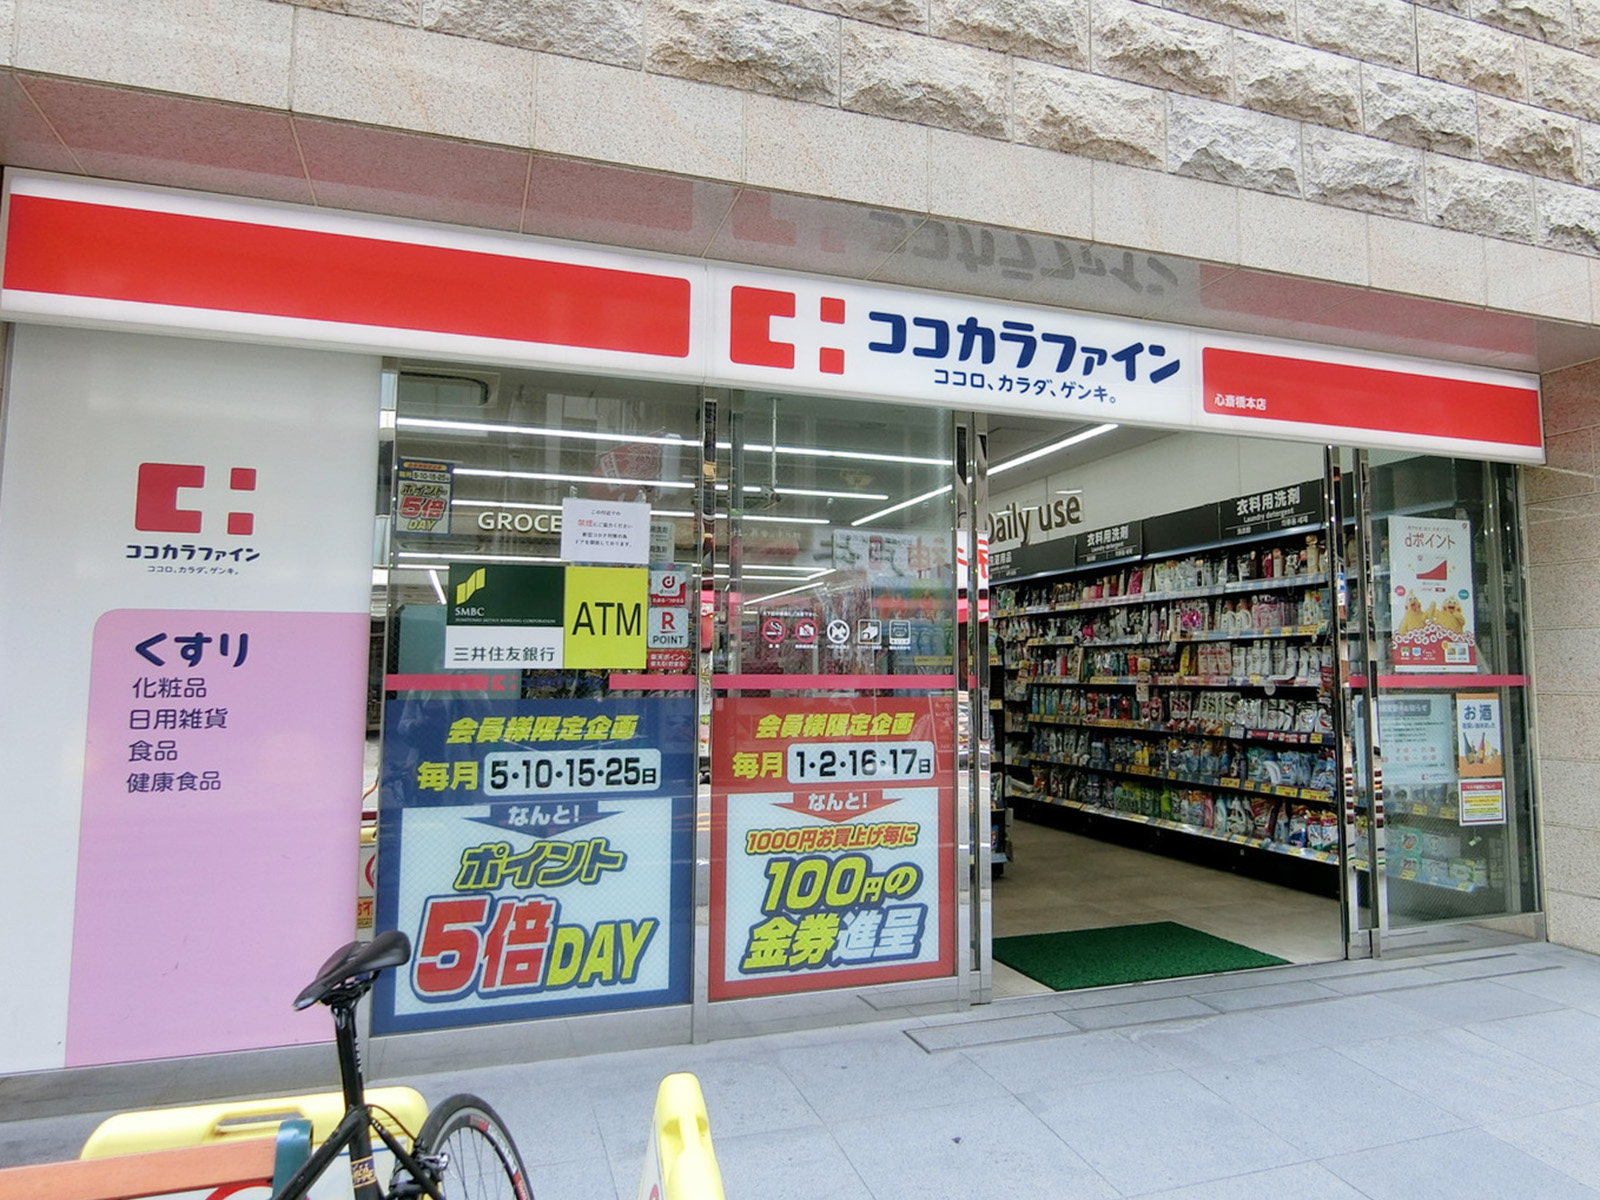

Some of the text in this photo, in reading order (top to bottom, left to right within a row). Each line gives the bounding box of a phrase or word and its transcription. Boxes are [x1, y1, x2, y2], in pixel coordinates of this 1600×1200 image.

[868, 311, 1181, 384] ココカラファイン
[934, 368, 1117, 404] ココロ、カラダ、ゲンキ。
[1214, 393, 1267, 411] 心斎橋本店
[400, 496, 447, 520] 5倍
[1236, 486, 1300, 516] 衣料用洗剤
[407, 519, 437, 531] DAY
[478, 511, 562, 533] GROCE
[1038, 496, 1082, 531] use
[1086, 524, 1129, 547] 衣料用洗剤
[1404, 532, 1456, 549] dポイント
[126, 544, 260, 562] ココカラファイン
[454, 607, 485, 617] SMBC
[571, 601, 642, 637] ATM
[135, 632, 249, 668] くすり
[652, 635, 684, 645] POINT
[453, 646, 555, 662] 三井住友銀行
[132, 677, 207, 699] 化粧品
[129, 708, 229, 730] 日用雑貨
[1464, 704, 1492, 721] お酒
[445, 714, 640, 744] 会員様限定企画
[755, 712, 915, 739] 会員様限定企画
[128, 740, 178, 763] 食品
[417, 760, 479, 791] 毎月
[732, 751, 783, 780] 毎月
[126, 771, 222, 794] 健康食品
[808, 792, 869, 812] なんと!
[507, 804, 580, 827] なんと!
[746, 822, 919, 854] 1000円お買上げ毎に
[453, 838, 627, 891] ポイント
[763, 853, 922, 915] 100円の
[740, 904, 927, 973] 金券進呈
